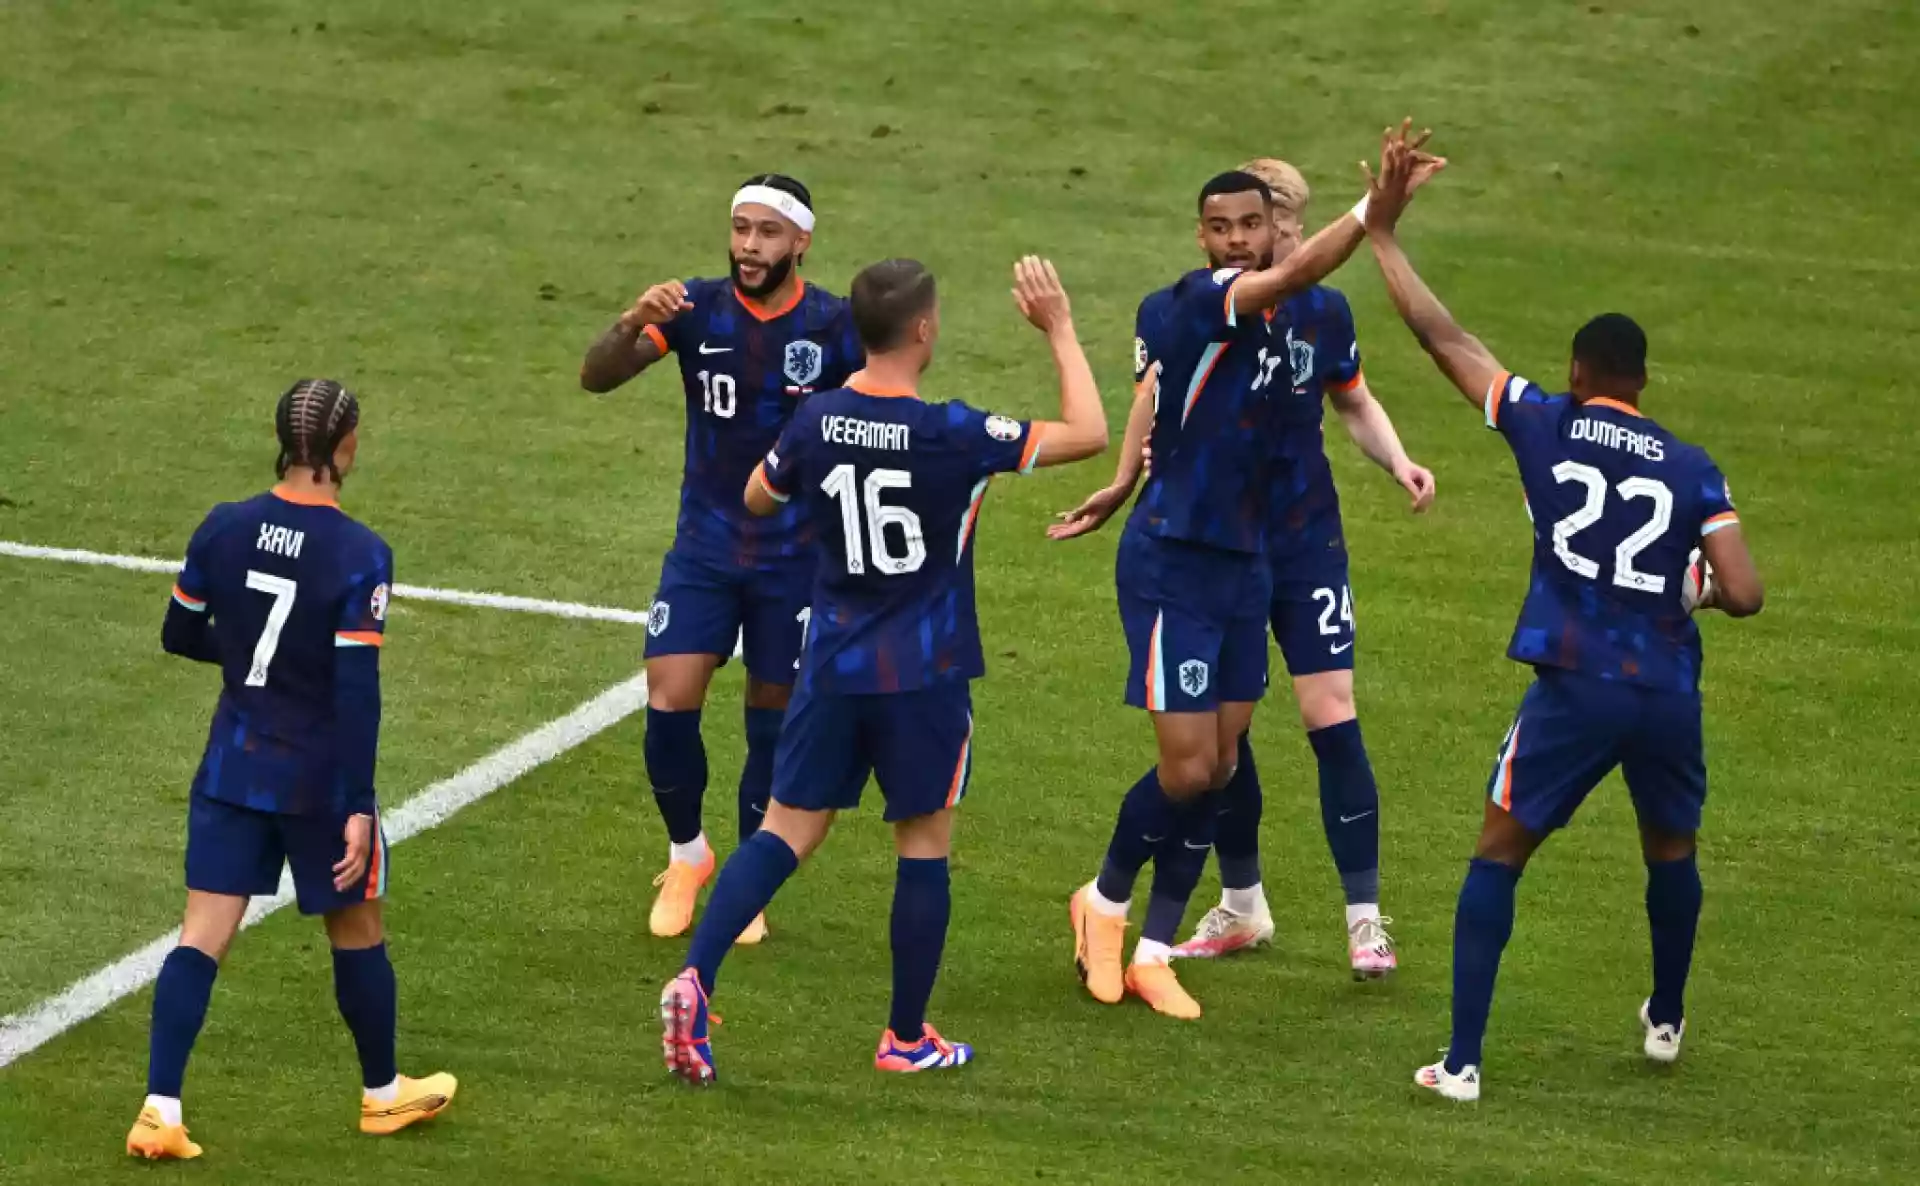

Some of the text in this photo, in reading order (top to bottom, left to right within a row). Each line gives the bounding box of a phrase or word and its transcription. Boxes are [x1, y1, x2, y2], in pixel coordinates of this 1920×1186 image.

[696, 369, 737, 419] 10
[820, 415, 911, 451] VEERMAN
[1570, 417, 1666, 463] DUMFRIES
[256, 522, 306, 559] XAVI
[819, 464, 928, 577] 16
[1551, 459, 1675, 594] 22
[243, 568, 298, 687] 7
[1311, 584, 1355, 636] 24
